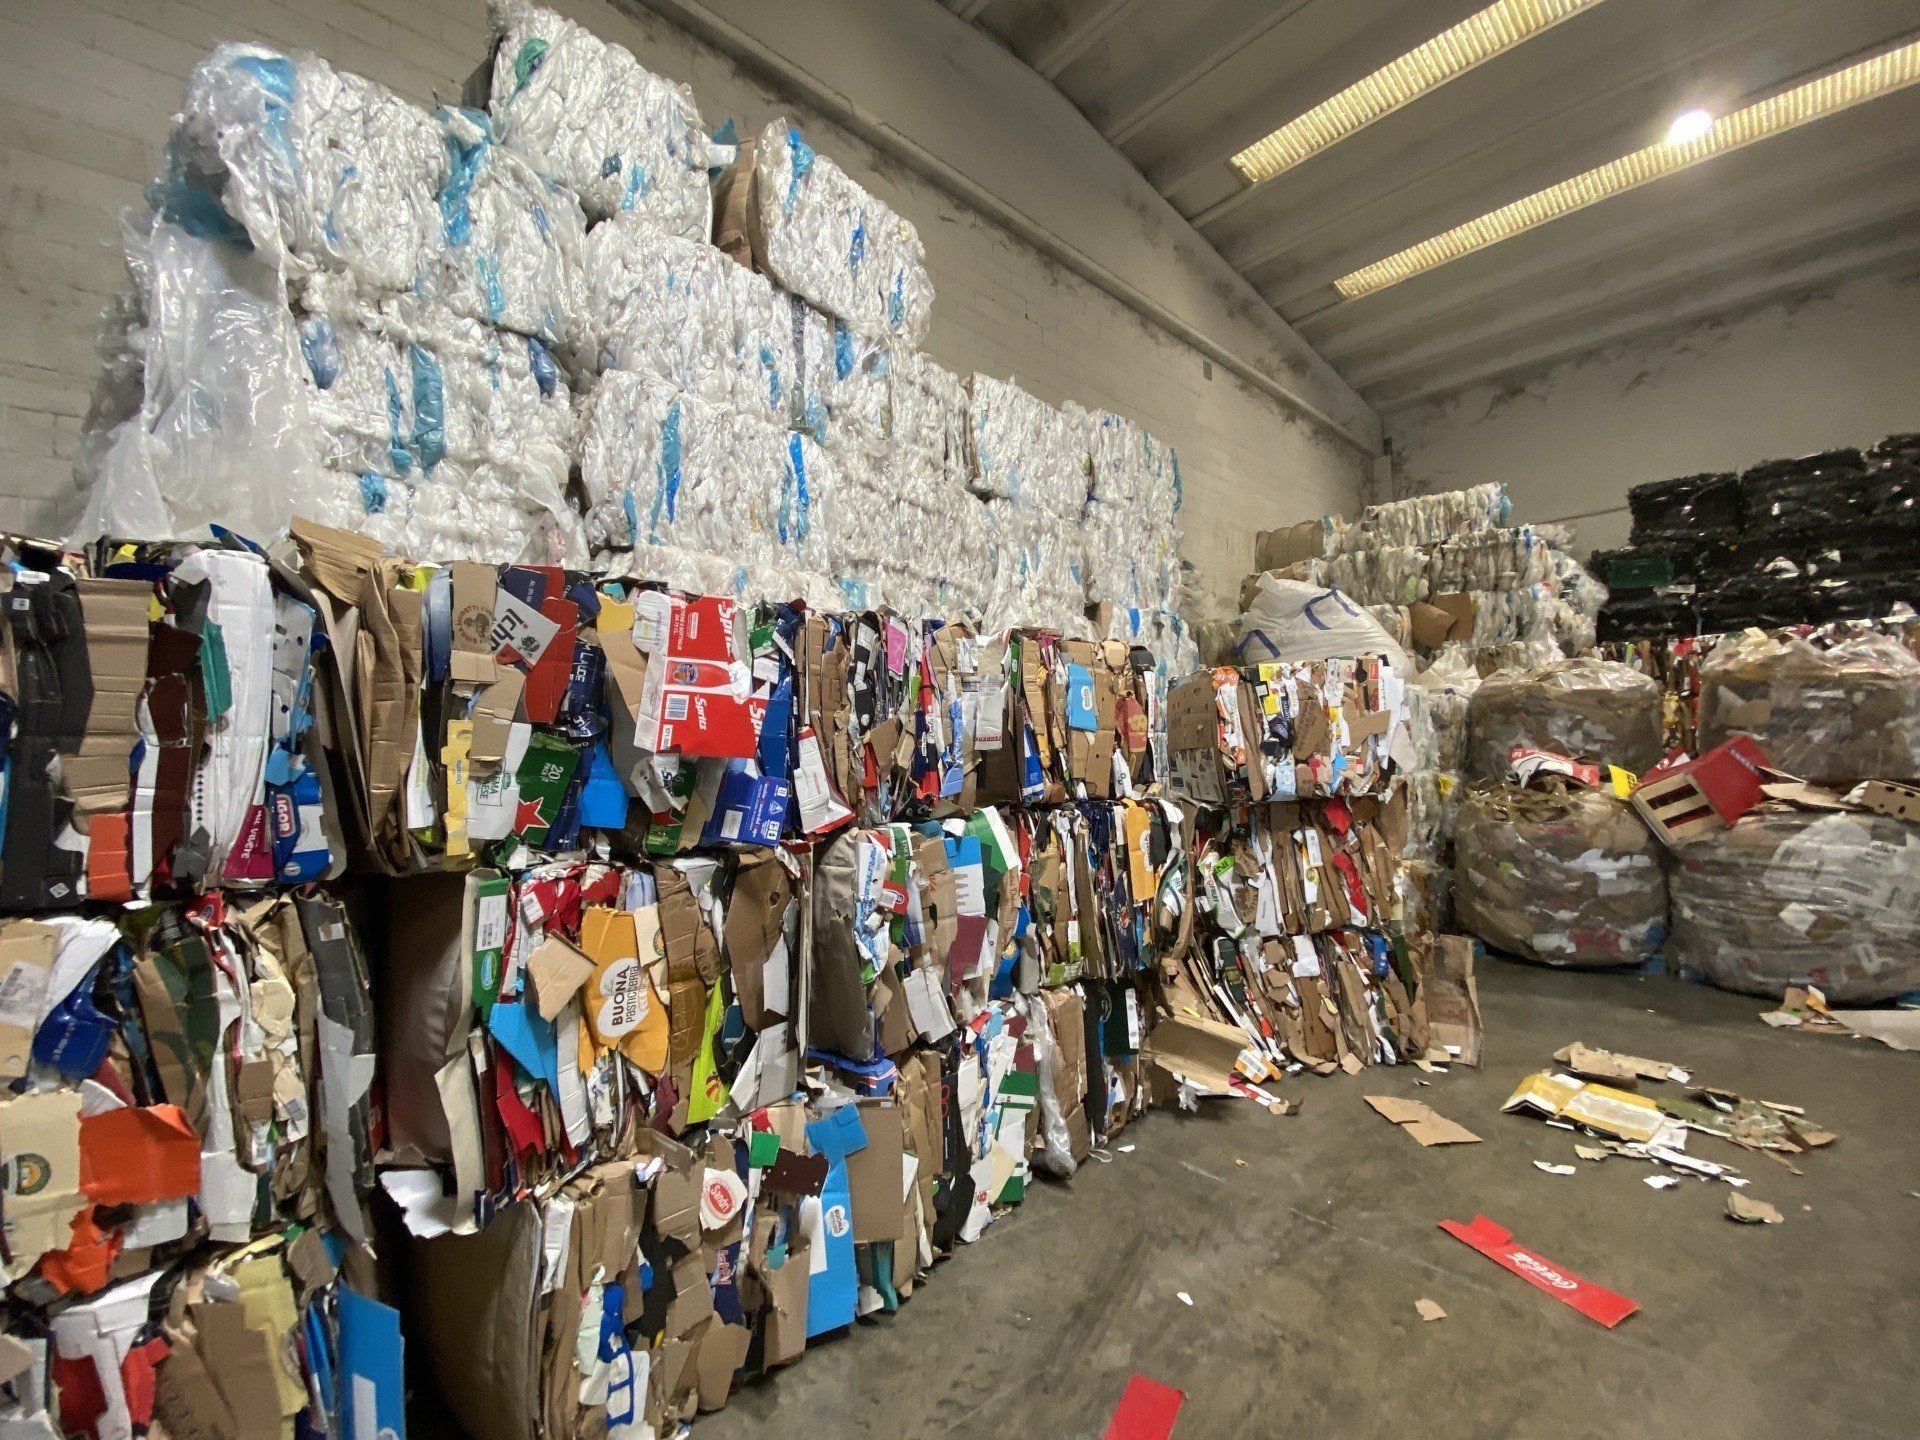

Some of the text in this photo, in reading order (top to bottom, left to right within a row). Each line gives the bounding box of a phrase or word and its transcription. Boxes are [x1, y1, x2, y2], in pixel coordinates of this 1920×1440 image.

[276, 799, 290, 832] IGOR
[612, 965, 629, 1025] BUONA
[711, 1187, 730, 1214] Sandri
